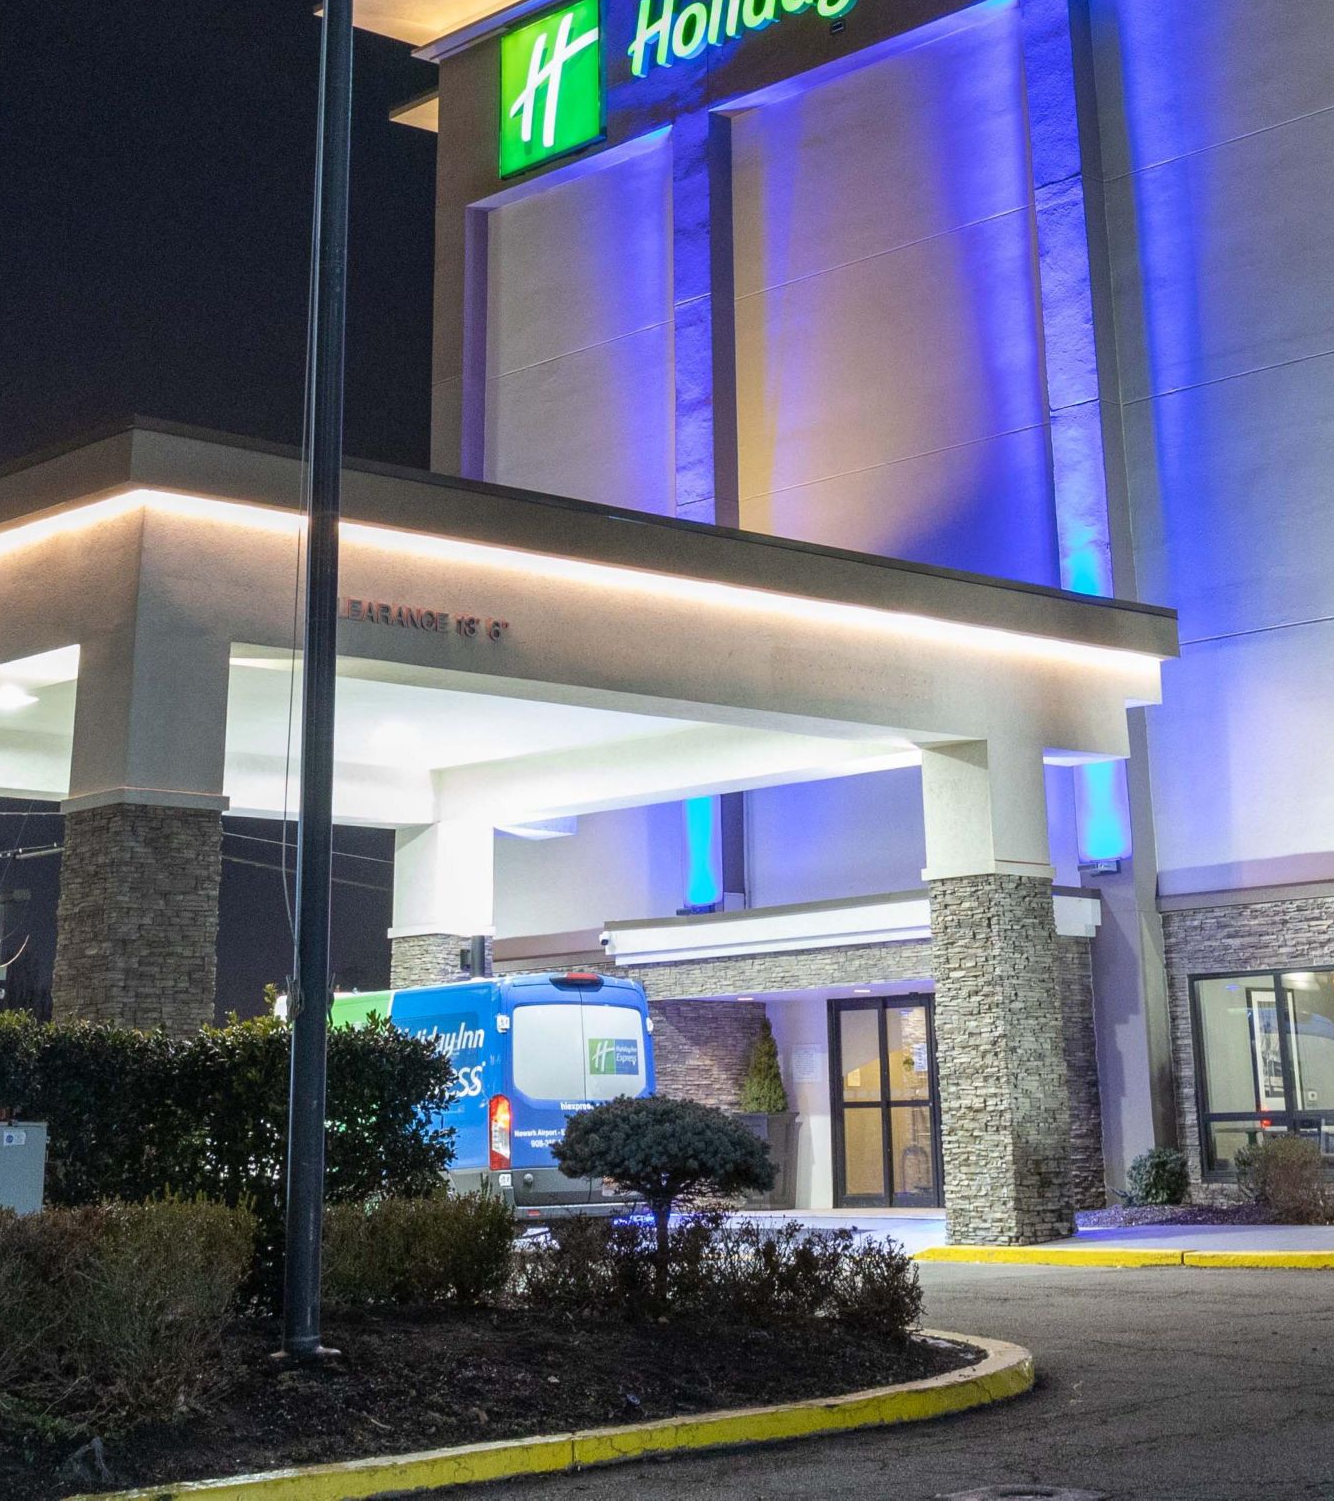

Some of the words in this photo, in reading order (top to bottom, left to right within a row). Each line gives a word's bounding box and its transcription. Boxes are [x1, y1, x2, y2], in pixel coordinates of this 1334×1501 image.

[335, 596, 450, 633] EARANCE
[456, 1022, 486, 1051] Inn
[537, 1128, 557, 1138] Airport
